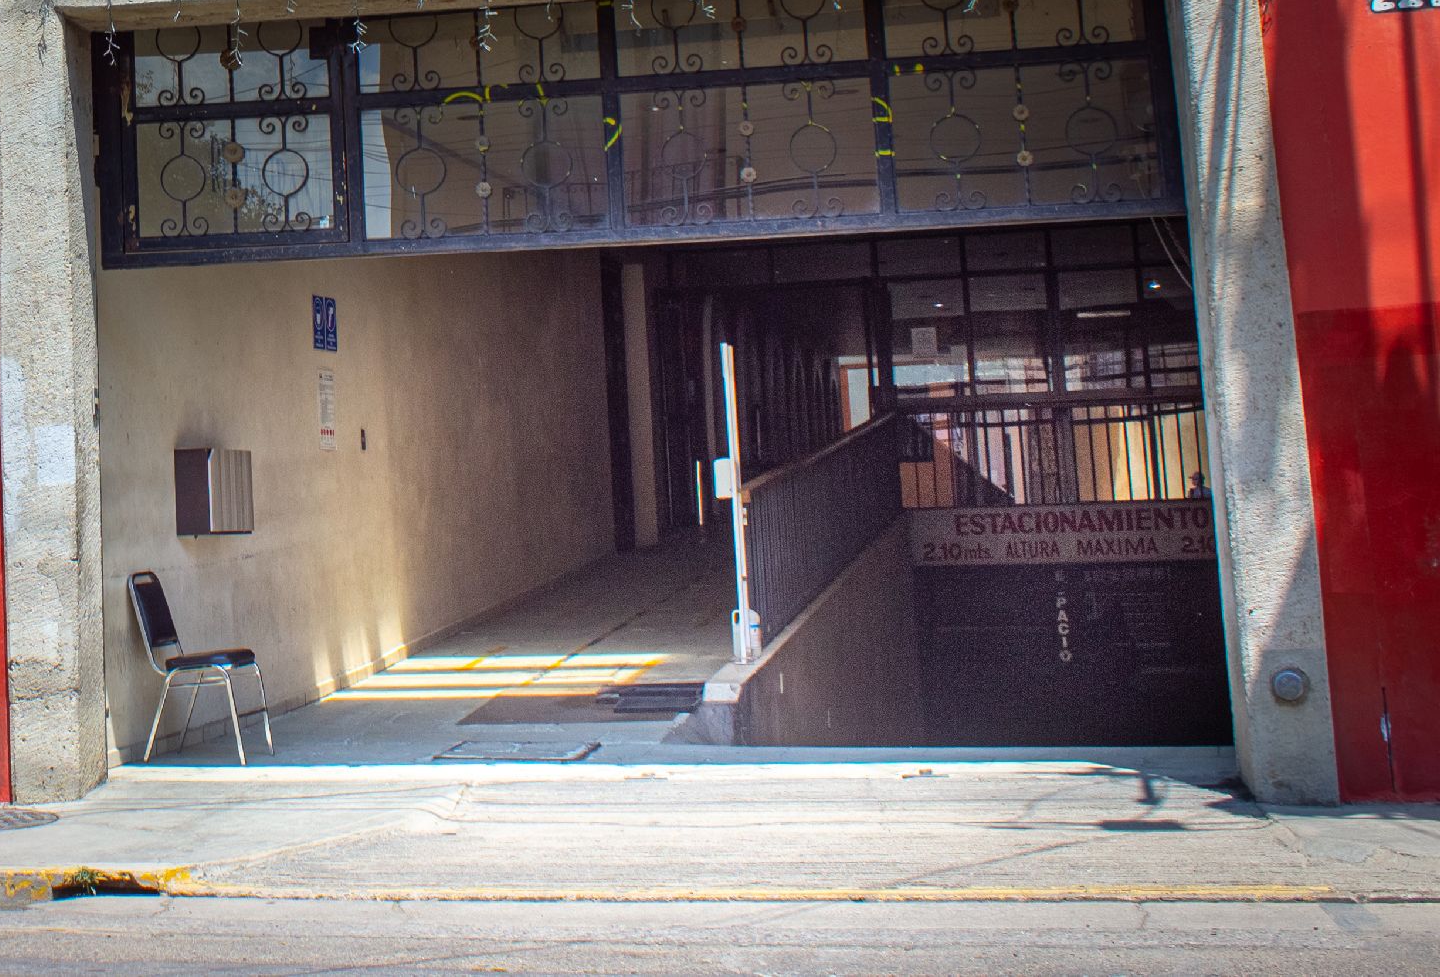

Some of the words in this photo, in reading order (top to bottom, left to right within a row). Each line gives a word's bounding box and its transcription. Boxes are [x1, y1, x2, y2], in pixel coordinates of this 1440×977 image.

[954, 506, 1209, 536] ESTACIONAMIENTO
[1005, 539, 1061, 560] ALTURA
[1076, 535, 1160, 557] MAXIMA
